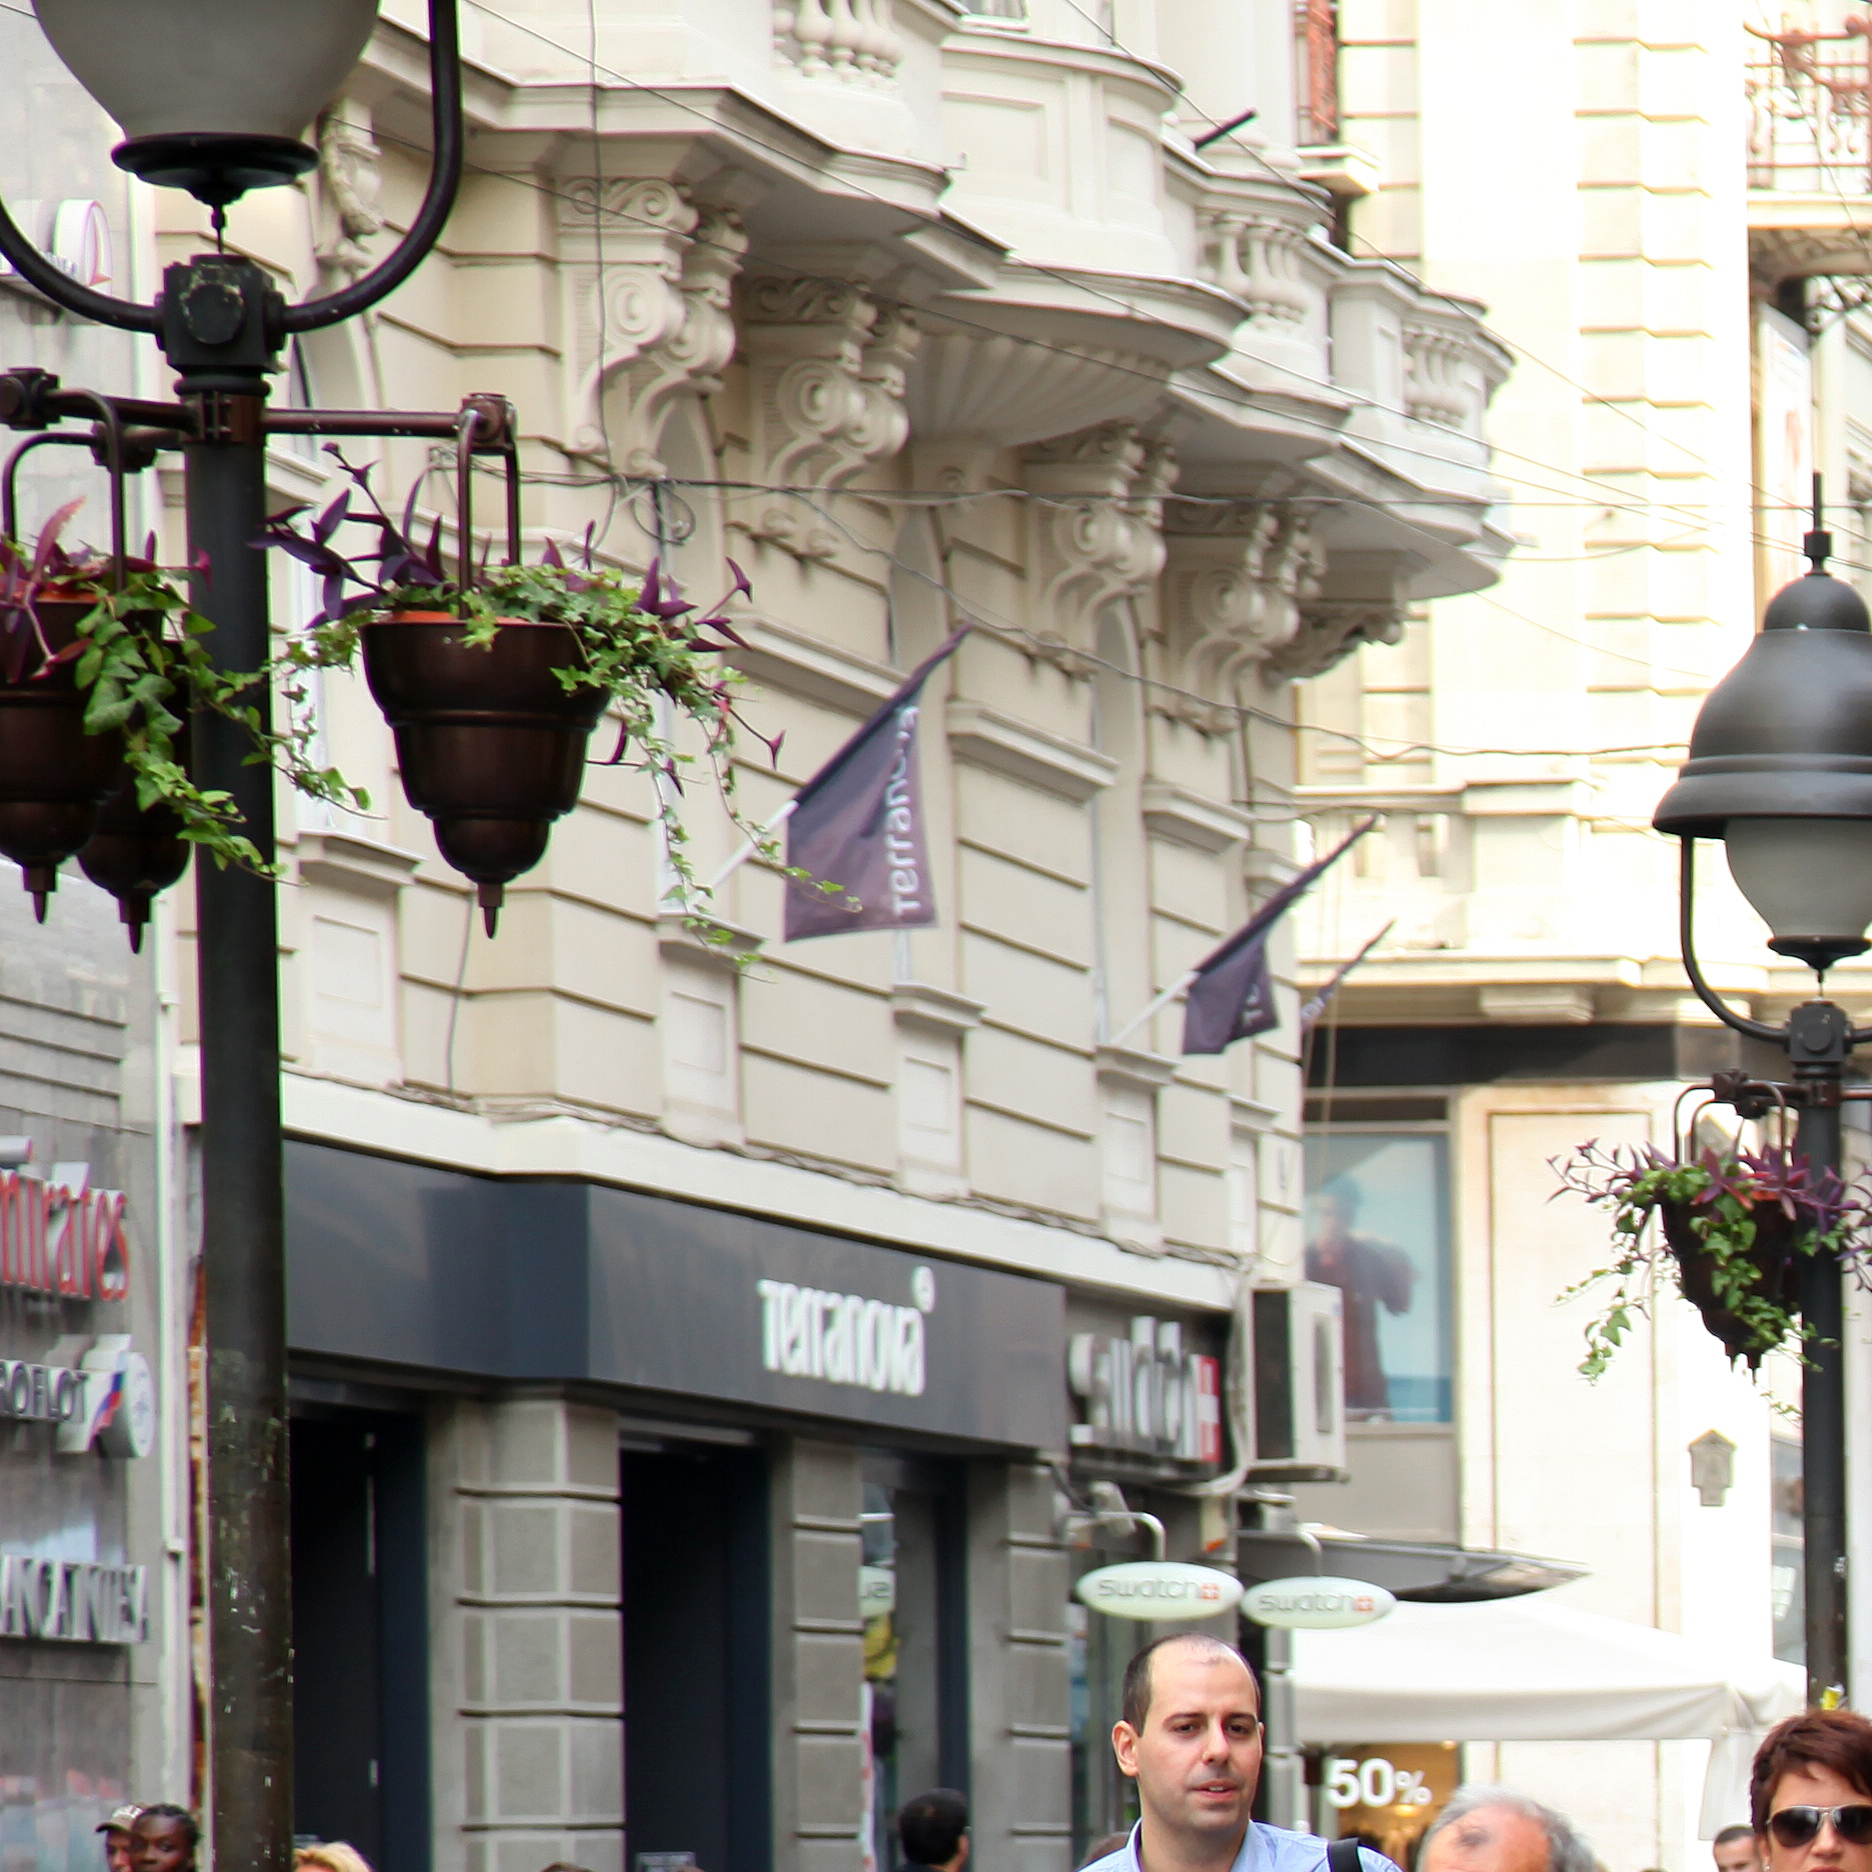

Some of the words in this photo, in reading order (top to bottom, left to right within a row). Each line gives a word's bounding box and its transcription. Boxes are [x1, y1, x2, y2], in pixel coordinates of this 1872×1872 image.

[1098, 1578, 1198, 1600] swatch
[1260, 1591, 1355, 1613] swatch
[1327, 1756, 1433, 1808] 50%
